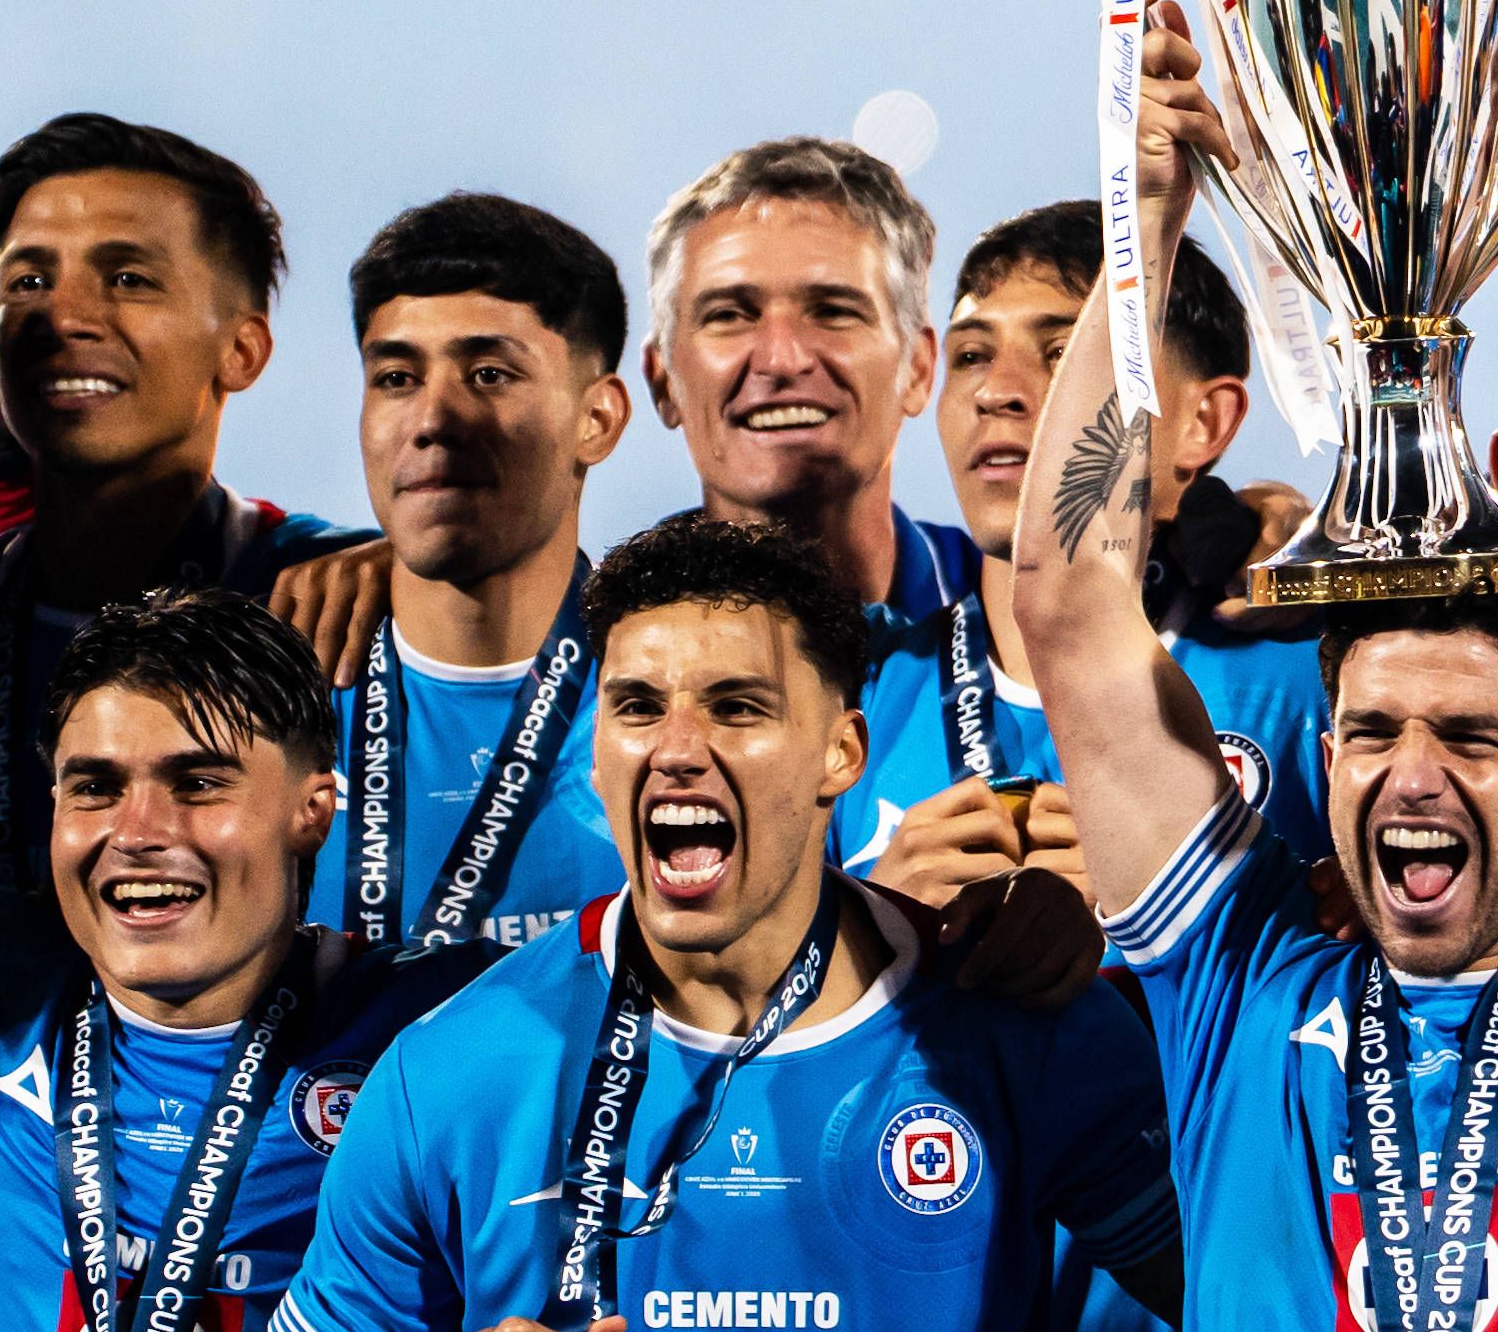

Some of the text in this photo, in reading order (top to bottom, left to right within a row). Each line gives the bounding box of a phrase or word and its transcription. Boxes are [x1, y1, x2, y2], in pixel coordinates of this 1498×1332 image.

[1110, 31, 1136, 125] Michelob
[1111, 163, 1151, 400] Michelob ULTRA
[365, 681, 391, 743] CUP
[511, 635, 582, 760] Concacaf
[358, 744, 391, 907] CHAMPIONS
[432, 760, 535, 930] CHAMPIONS
[225, 985, 298, 1119] Concacaf
[610, 999, 645, 1062] CUP
[738, 941, 822, 1060] CUP 2025
[1359, 1015, 1389, 1064] CUP
[884, 1119, 904, 1150] CLUB
[910, 1109, 925, 1119] DE
[1363, 1066, 1409, 1242] CHAMPIONS
[70, 1102, 109, 1283] CHAMPIONS
[162, 1116, 243, 1283] CHAMPIONS
[898, 1188, 967, 1211] CRUZ AZUL
[643, 1290, 840, 1329] CEMENTO
[1432, 1235, 1469, 1304] CUP
